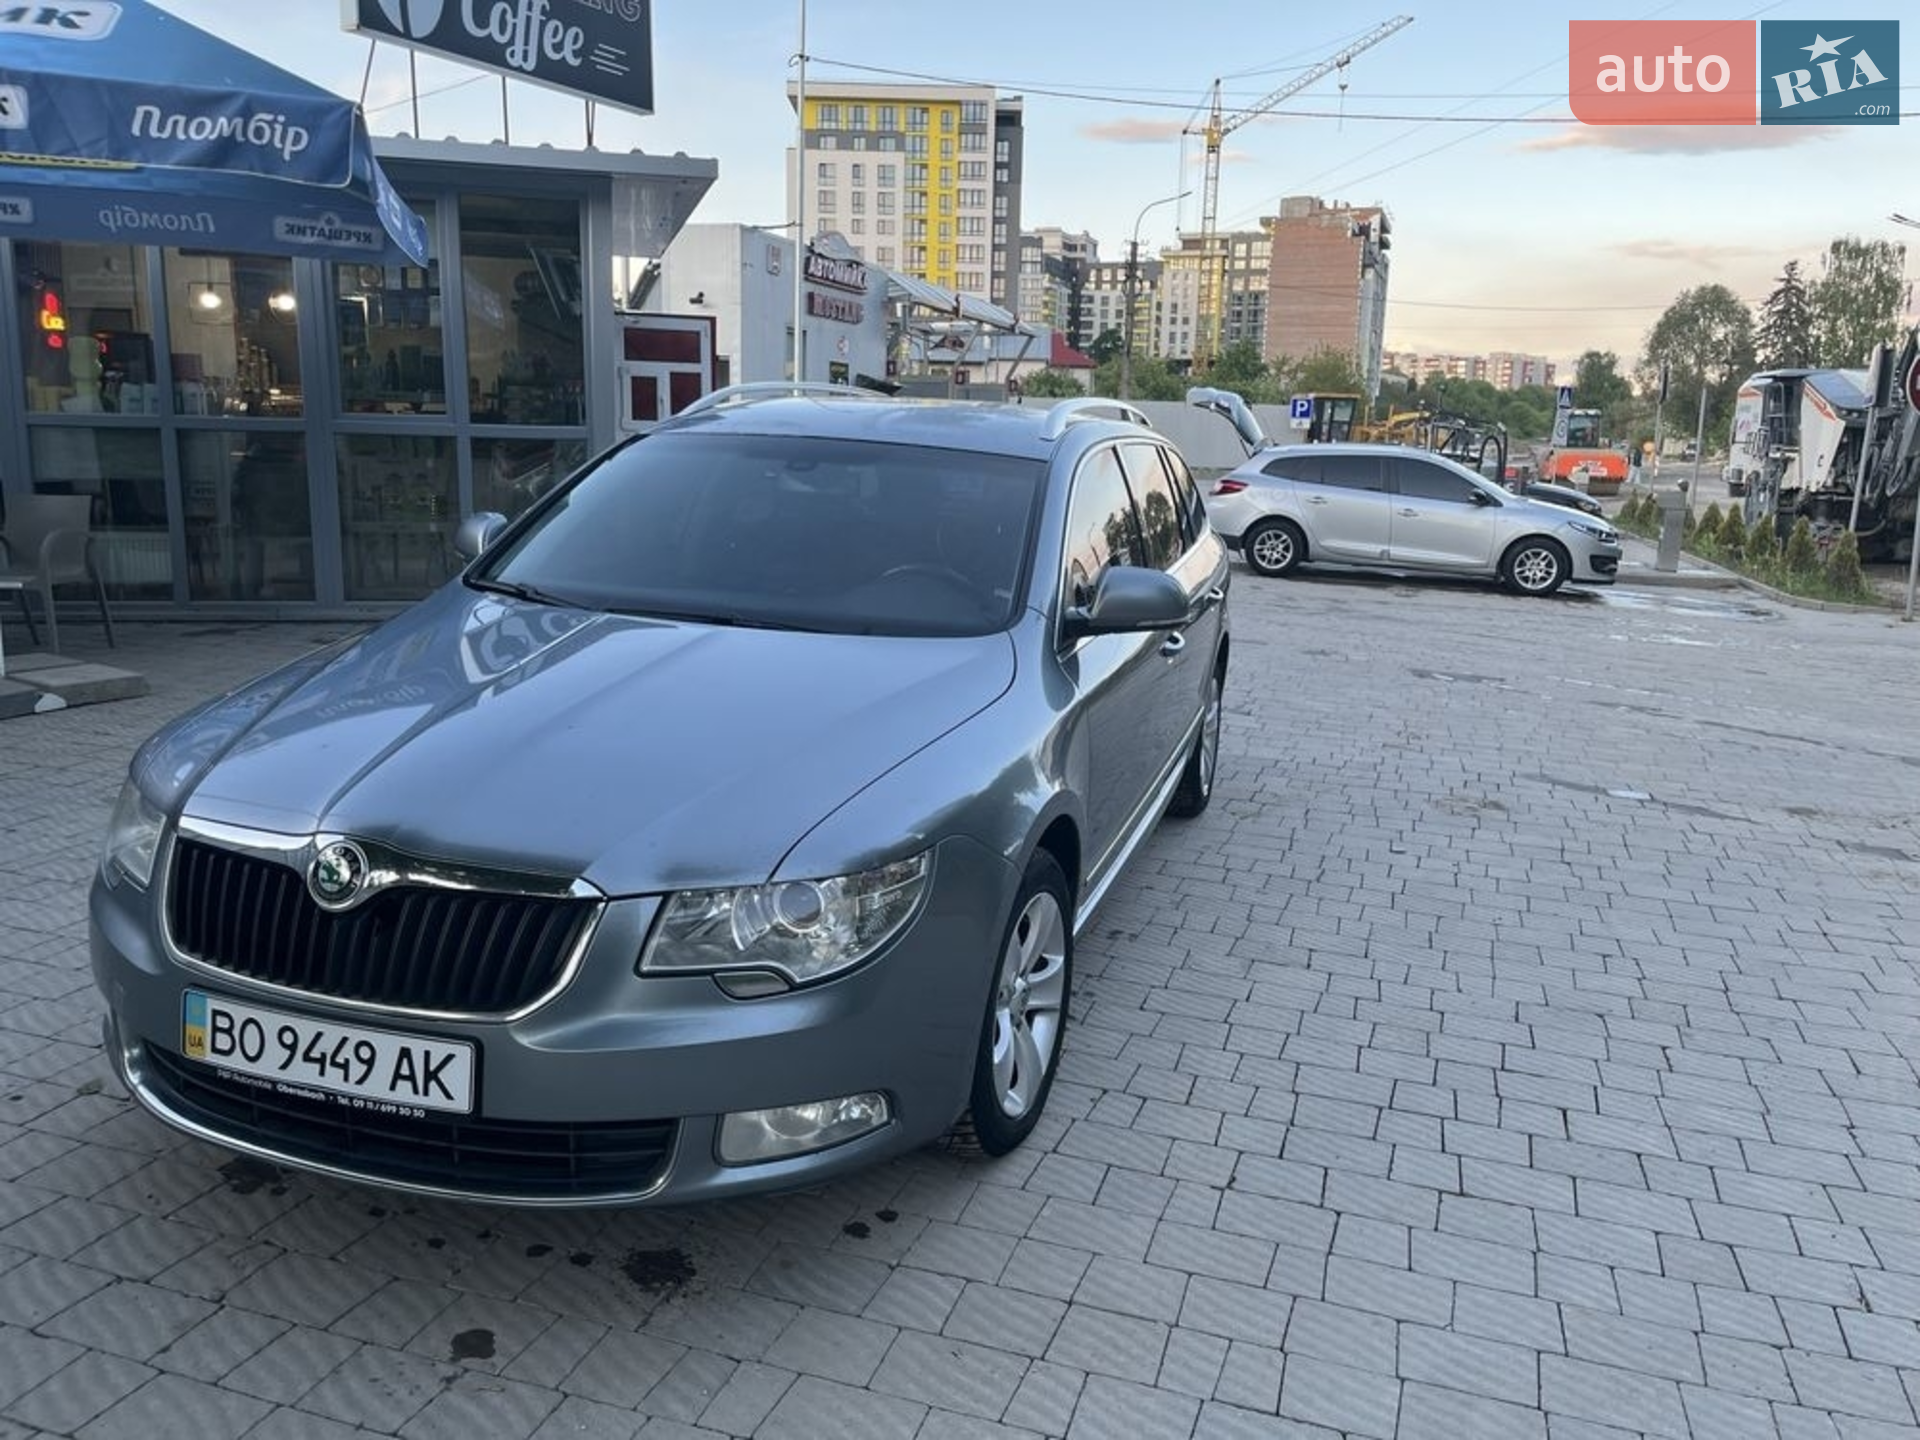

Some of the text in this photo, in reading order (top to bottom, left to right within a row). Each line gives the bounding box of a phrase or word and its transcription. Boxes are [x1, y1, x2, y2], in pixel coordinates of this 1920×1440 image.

[460, 0, 585, 72] Coffee
[131, 105, 310, 161] Пломбір
[1296, 400, 1309, 417] P
[188, 1034, 204, 1049] UA
[277, 1025, 378, 1086] 9449
